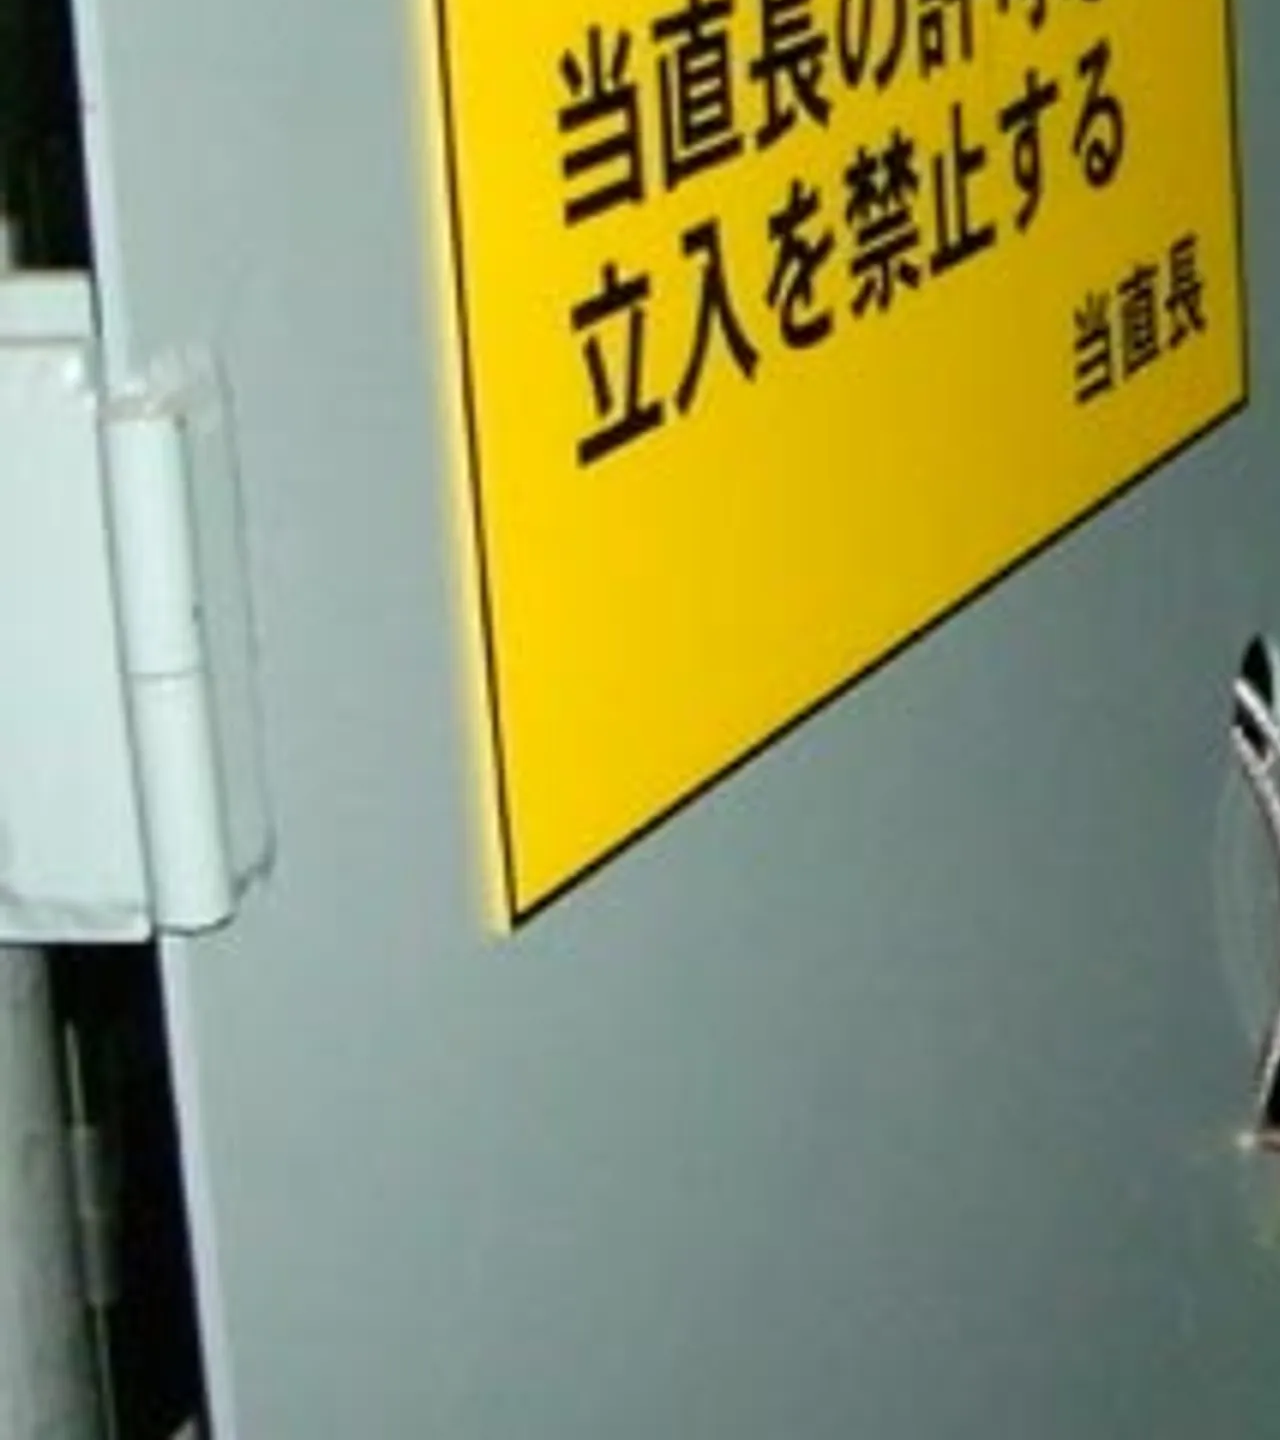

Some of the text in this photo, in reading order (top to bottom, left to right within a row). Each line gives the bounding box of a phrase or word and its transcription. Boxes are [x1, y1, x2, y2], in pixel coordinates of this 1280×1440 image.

[570, 37, 1124, 467] 立入を禁止する
[1073, 233, 1207, 405] 当直長
